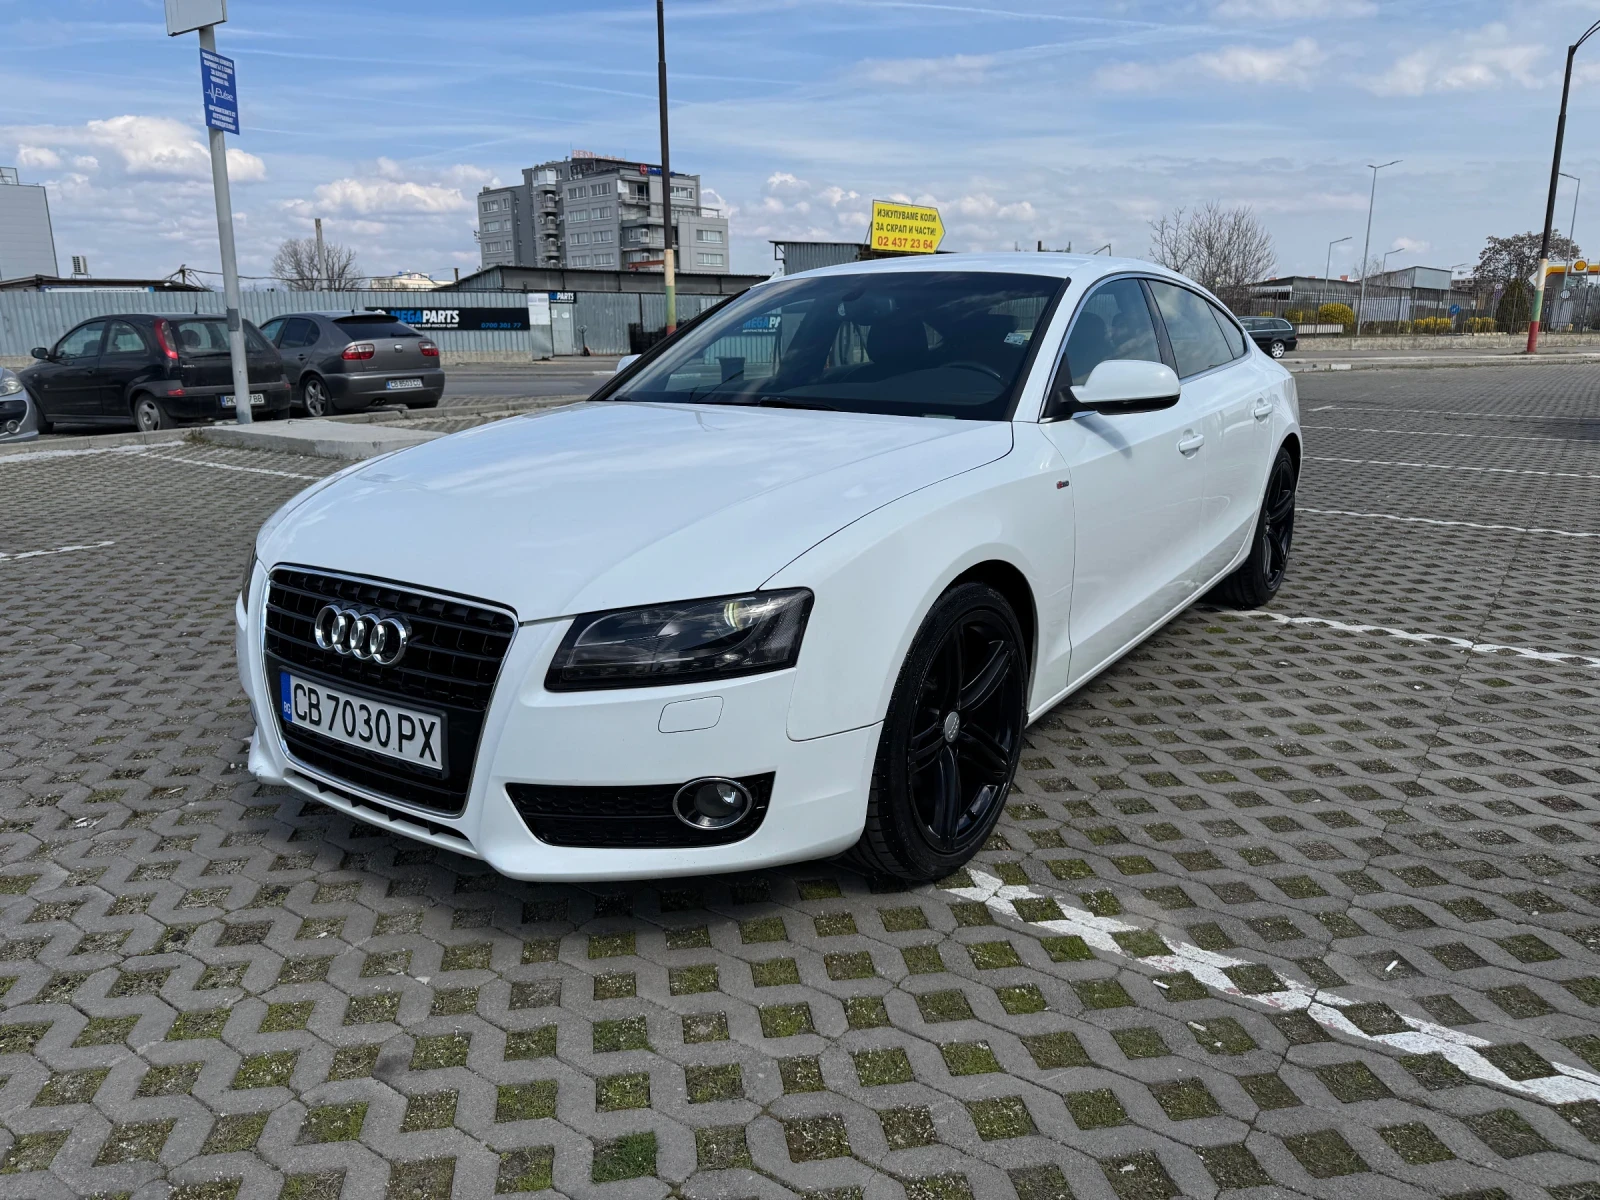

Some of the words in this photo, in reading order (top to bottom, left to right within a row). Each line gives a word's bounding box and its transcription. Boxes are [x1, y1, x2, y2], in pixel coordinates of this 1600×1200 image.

[877, 208, 919, 221] ИЗКУПУВАМЕ
[920, 213, 937, 223] КОЛИ
[876, 222, 885, 232] ЗА
[886, 223, 907, 234] СКРАП
[908, 226, 913, 234] И
[914, 226, 937, 236] ЧАСТИ!
[877, 236, 889, 246] 02
[892, 237, 908, 248] 437
[910, 239, 921, 249] 23
[923, 239, 933, 249] 64
[283, 701, 291, 714] BG
[326, 693, 391, 748] 7030
[397, 713, 437, 762] PX
